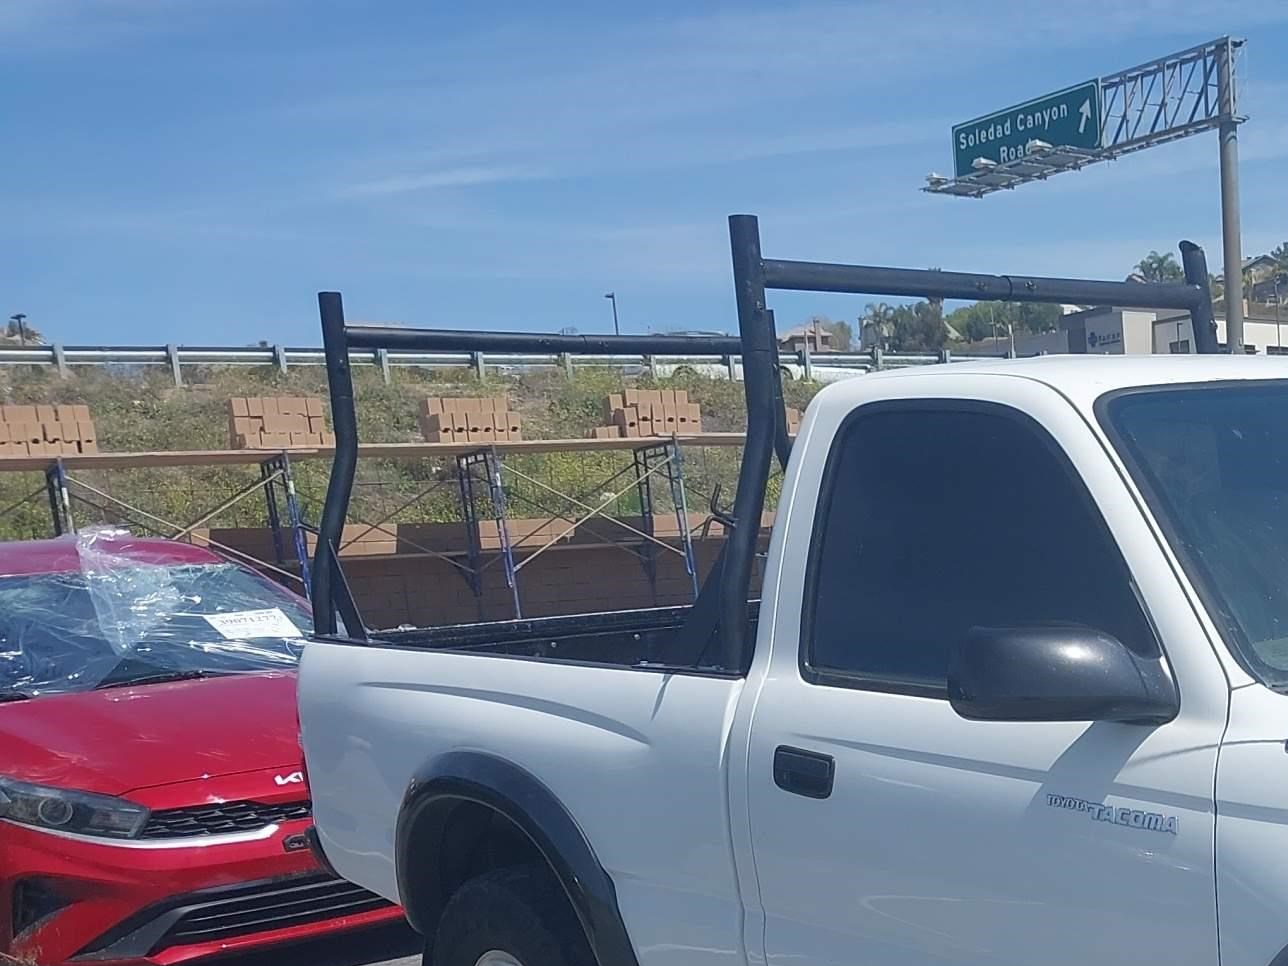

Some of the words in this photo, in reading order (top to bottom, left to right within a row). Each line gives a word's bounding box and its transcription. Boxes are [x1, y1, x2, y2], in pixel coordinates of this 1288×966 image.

[959, 117, 1011, 149] Soledad
[1017, 103, 1068, 130] Canyon
[1047, 794, 1089, 812] TOYOTA
[1088, 802, 1179, 835] TACOMA
